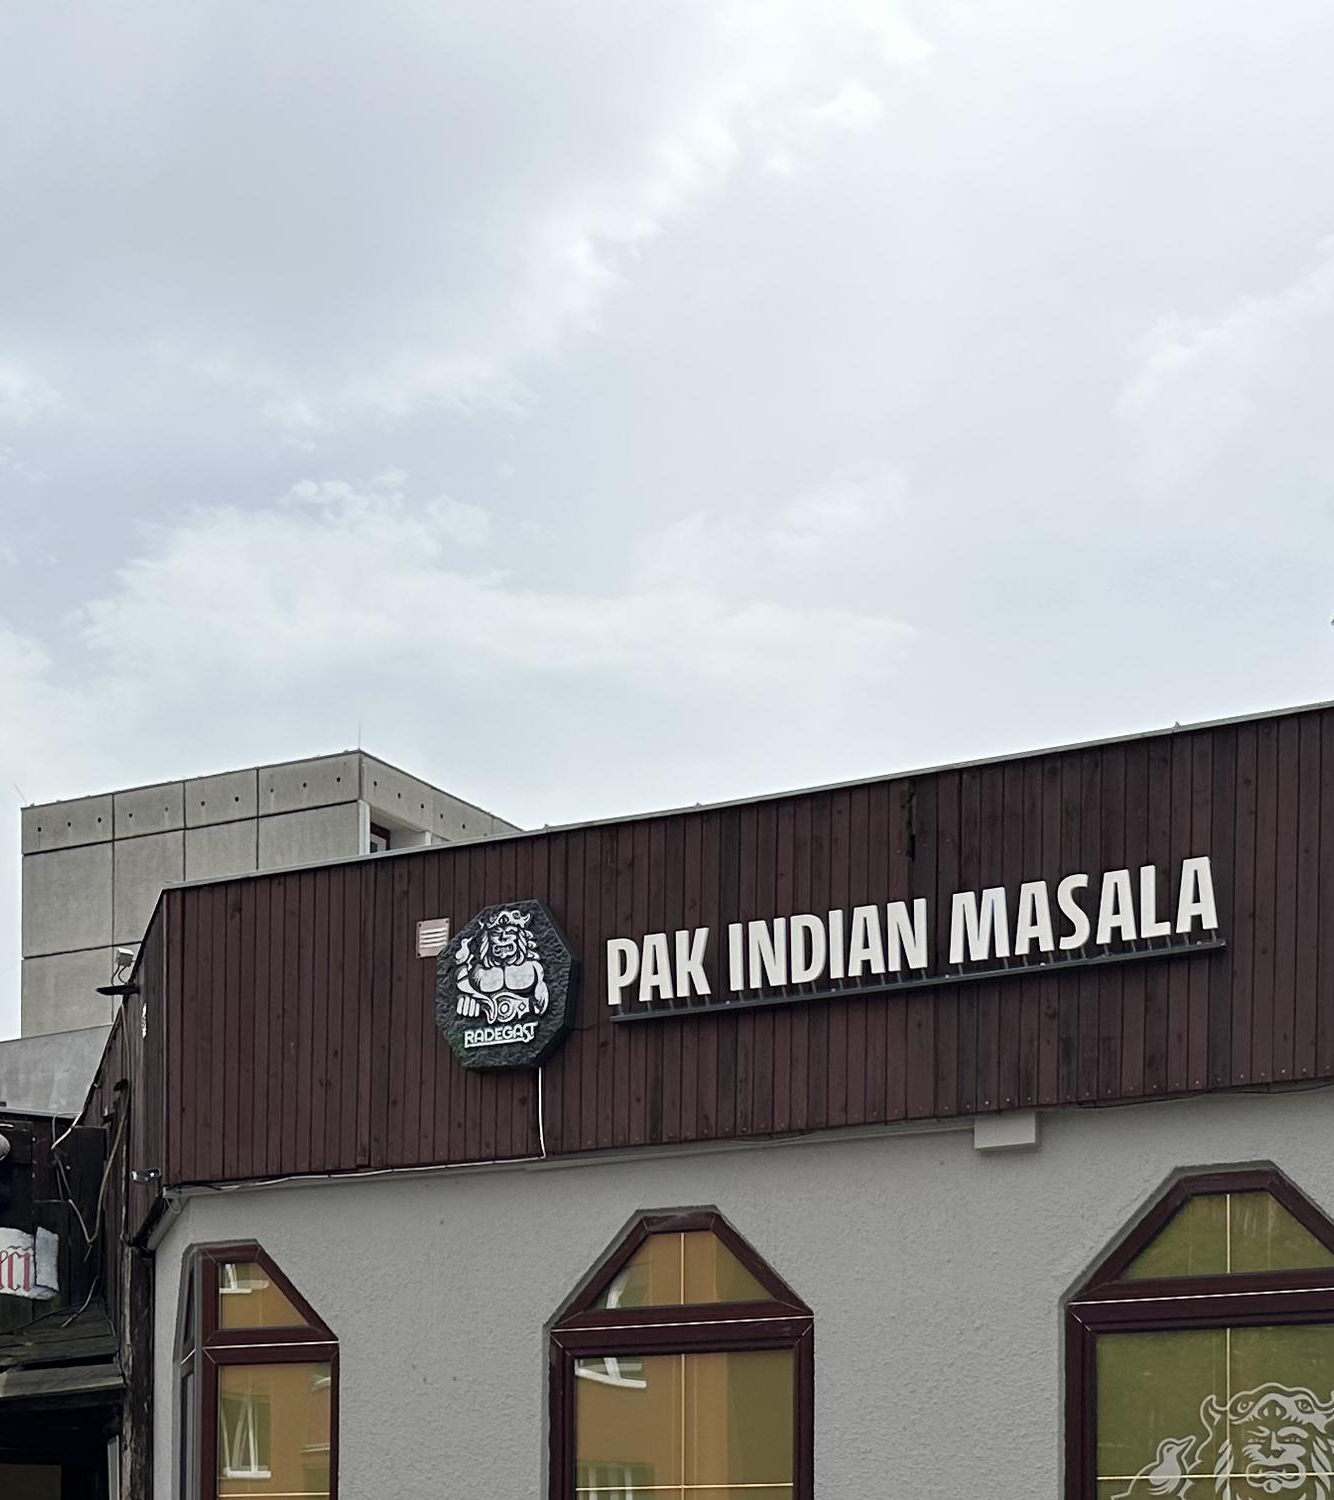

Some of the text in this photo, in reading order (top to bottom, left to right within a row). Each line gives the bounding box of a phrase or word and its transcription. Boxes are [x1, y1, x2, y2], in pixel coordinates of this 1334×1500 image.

[607, 856, 1218, 1005] PAK INDIAN MASALA
[464, 1021, 539, 1048] RADEGAST
